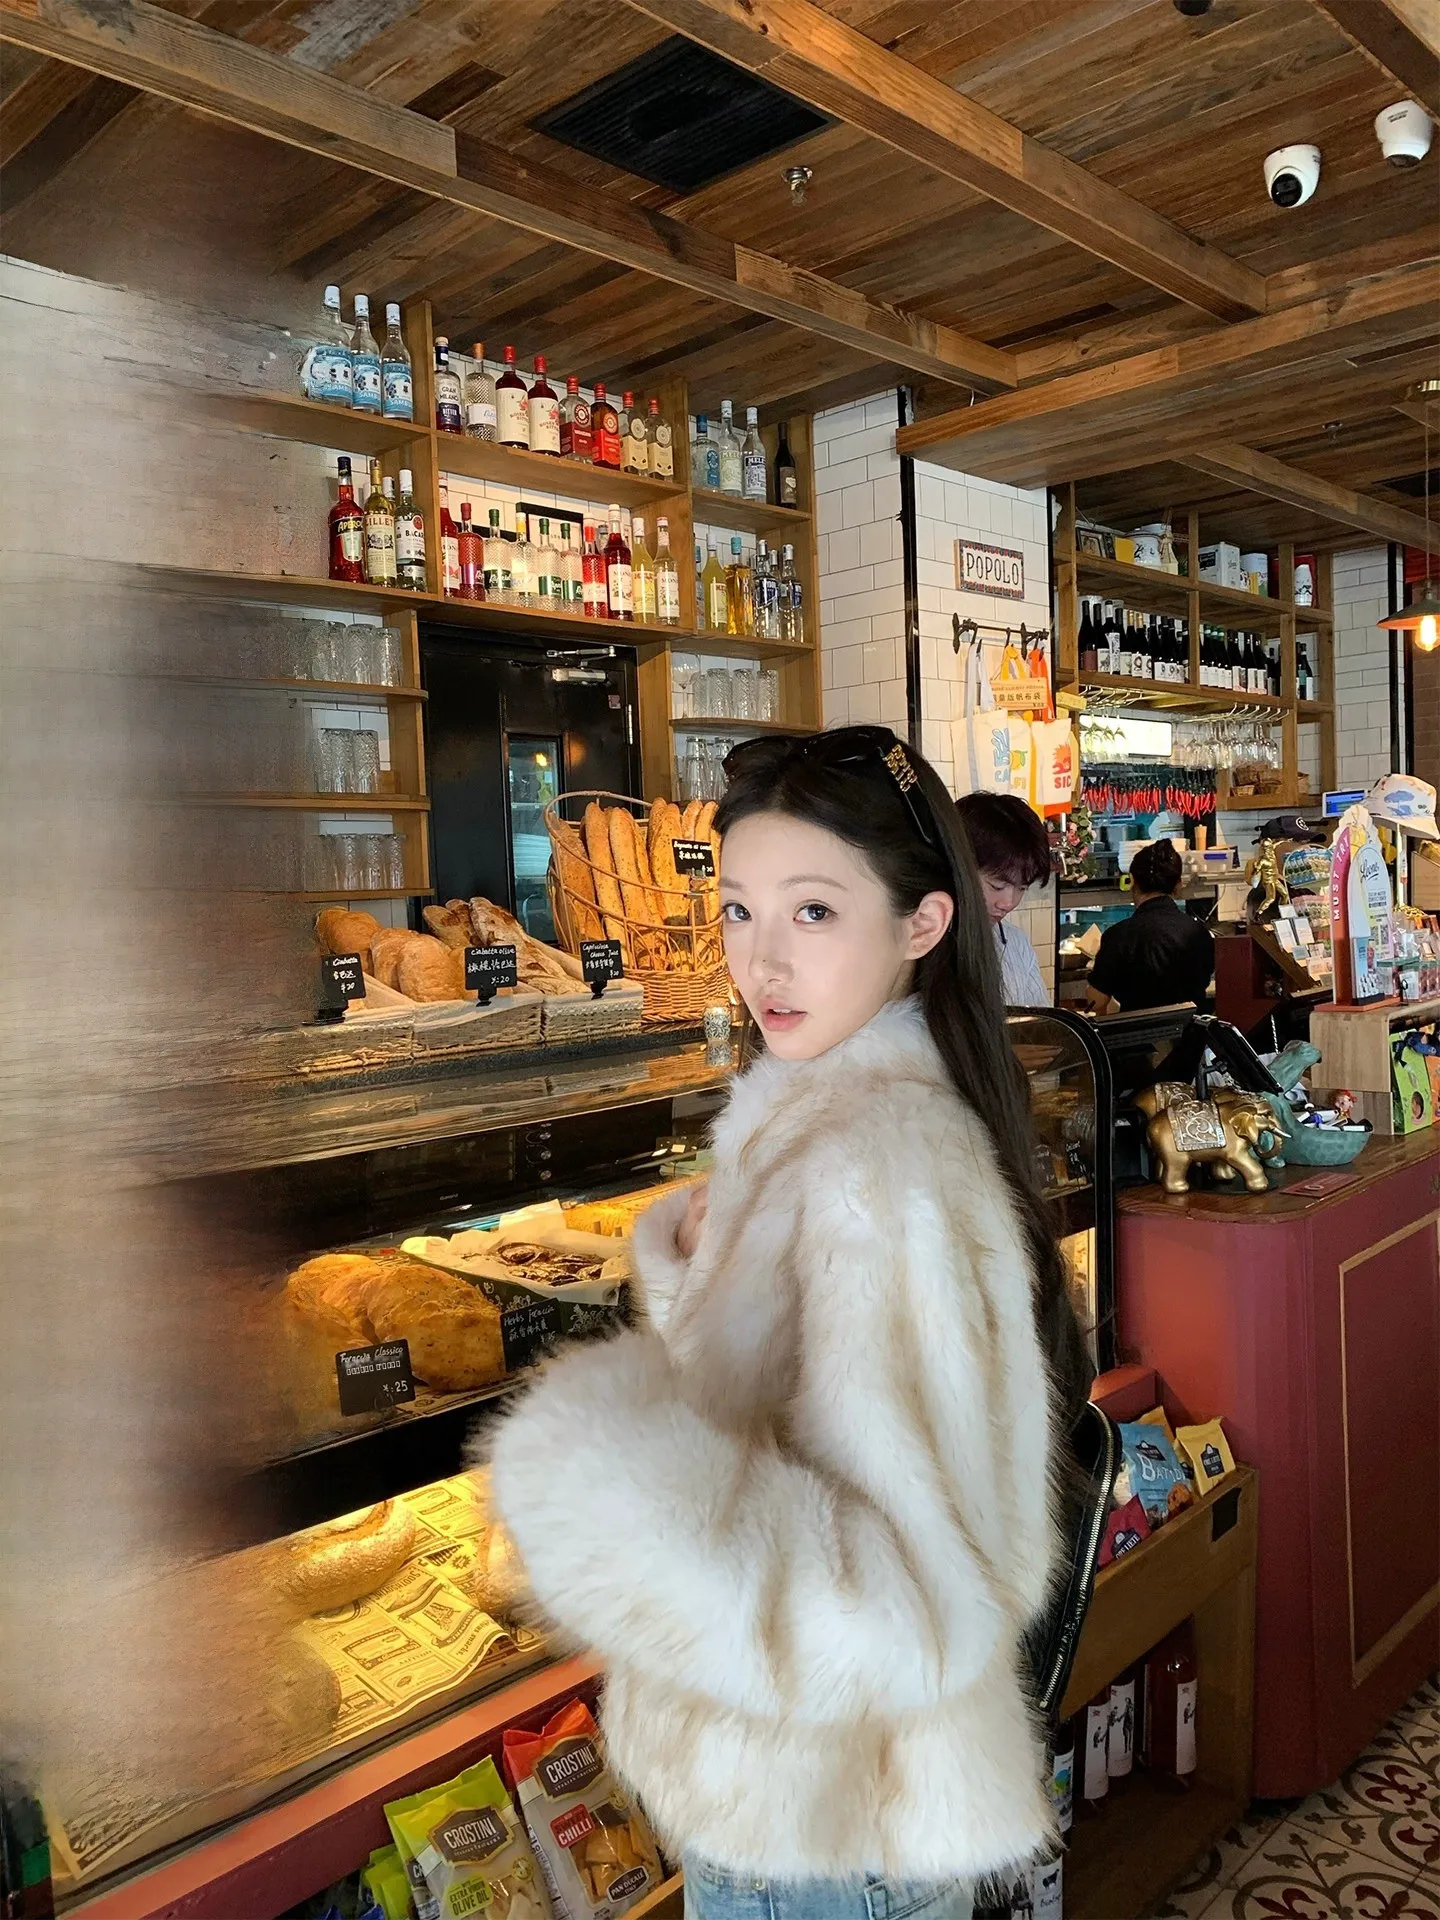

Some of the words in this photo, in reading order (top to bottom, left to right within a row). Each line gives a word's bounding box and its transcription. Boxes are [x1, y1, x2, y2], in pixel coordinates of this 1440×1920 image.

[966, 552, 1019, 586] POPOLO
[1332, 870, 1340, 920] MUST
[1336, 835, 1350, 862] TRY
[374, 1346, 404, 1358] Classico
[545, 1745, 596, 1784] CROSTINI
[443, 1817, 498, 1849] CROSTINI
[558, 1818, 593, 1846] CHILLI
[449, 1888, 468, 1903] EXTRA
[611, 1885, 625, 1896] PAN
[623, 1871, 646, 1889] DUCALE
[452, 1895, 478, 1916] OLIVE
[476, 1889, 490, 1904] OIL
